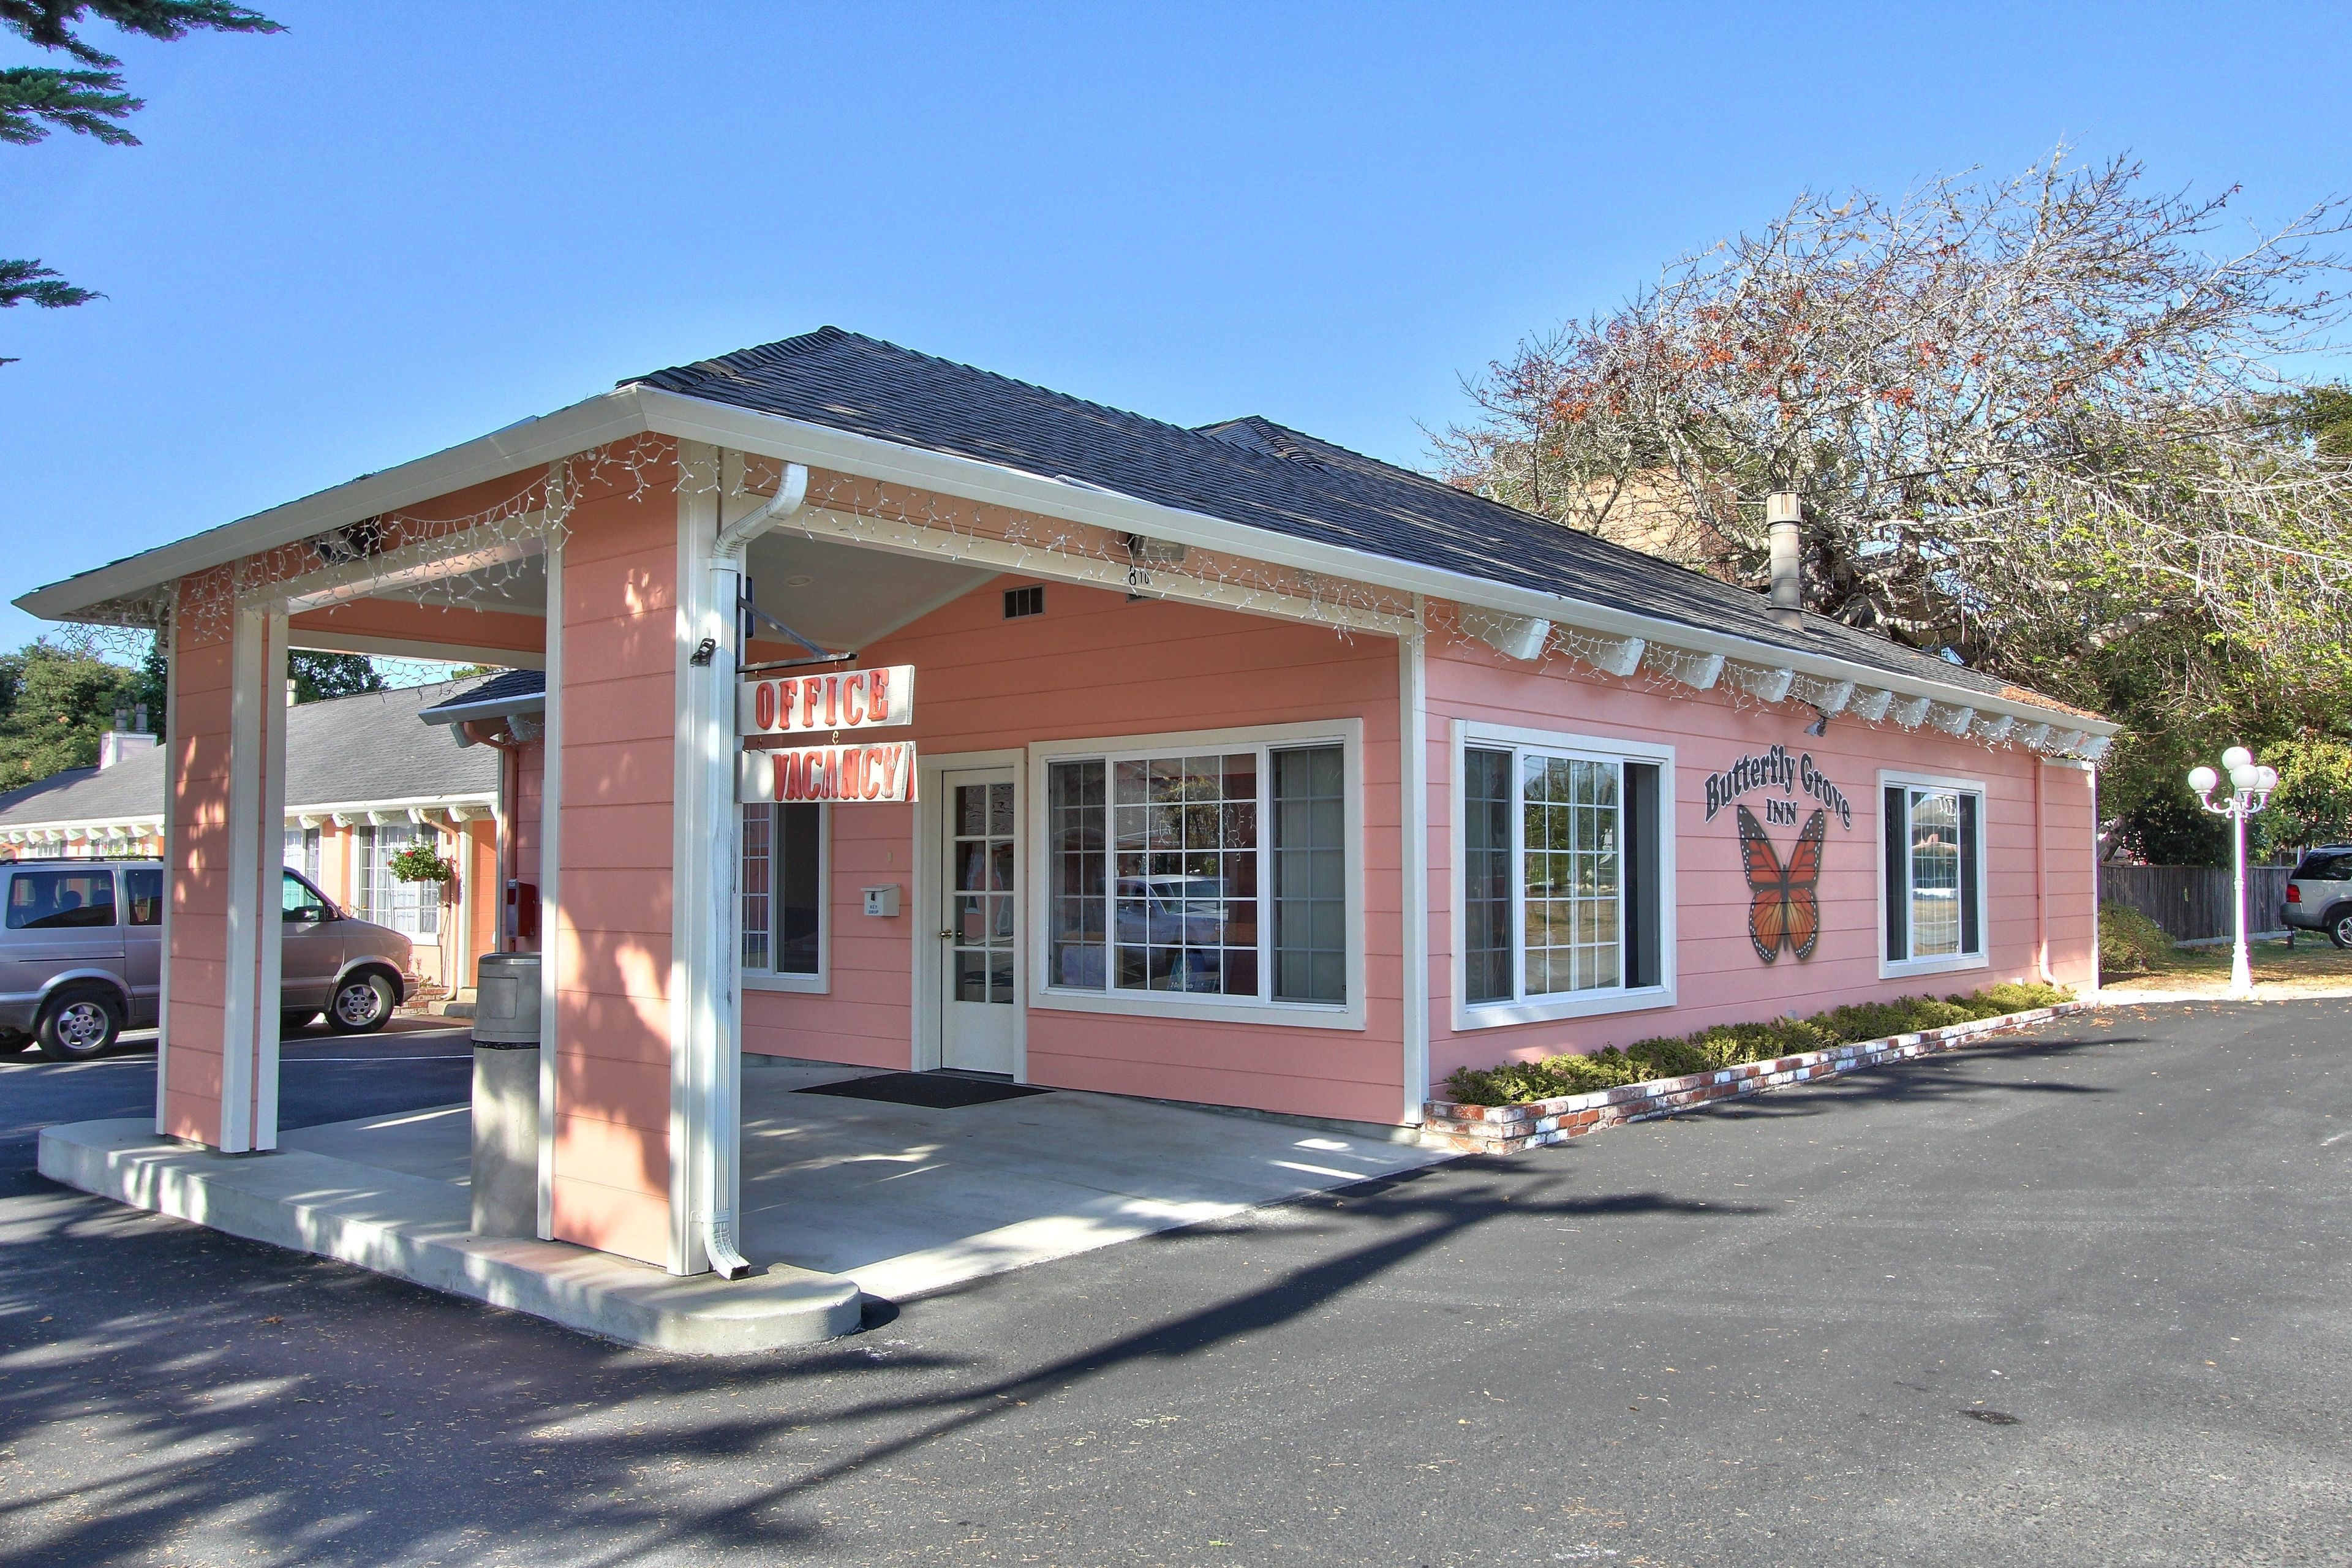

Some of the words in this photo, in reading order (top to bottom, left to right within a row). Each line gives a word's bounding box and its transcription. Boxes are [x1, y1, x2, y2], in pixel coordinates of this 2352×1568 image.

[1129, 565, 1149, 585] 810
[755, 668, 889, 730] OFFICE
[772, 746, 902, 802] VACANCY
[1705, 744, 1796, 823] Butterfly
[1800, 752, 1851, 830] Grove
[1766, 797, 1798, 826] INN
